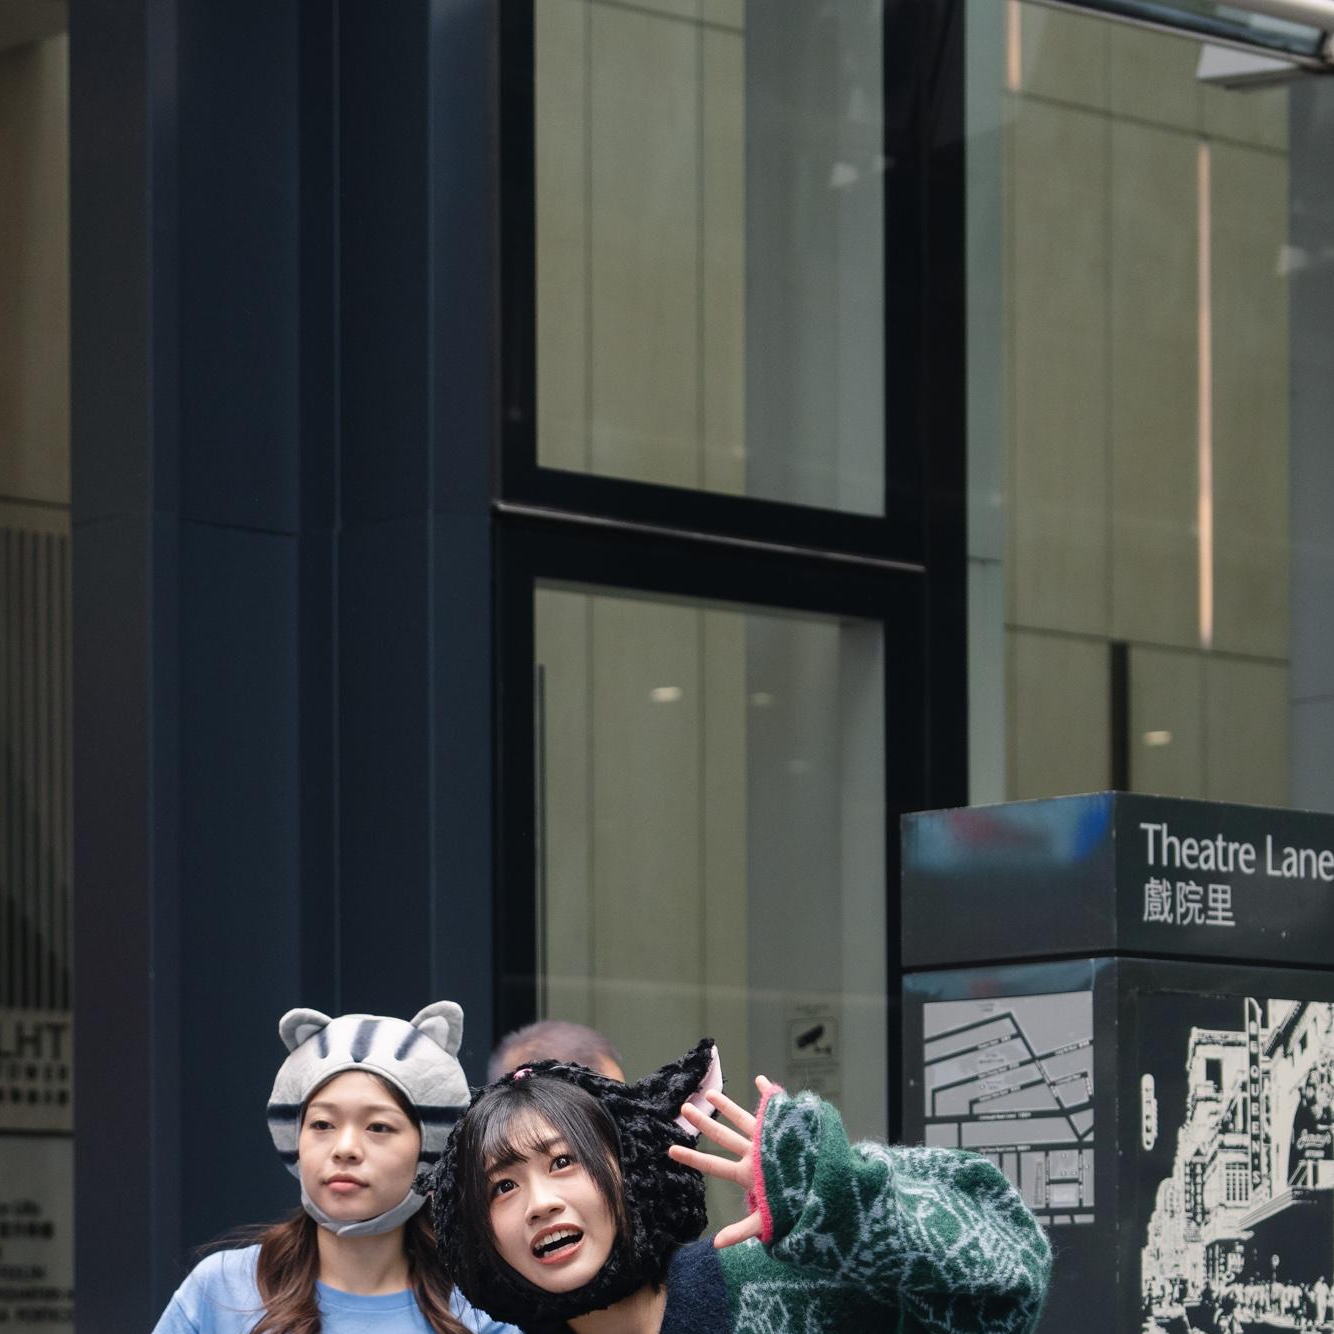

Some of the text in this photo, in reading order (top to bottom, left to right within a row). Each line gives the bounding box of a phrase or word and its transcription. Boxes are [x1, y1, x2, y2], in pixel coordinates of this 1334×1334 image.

[1139, 822, 1334, 881] Theatre Lane
[1143, 877, 1235, 926] 戲院里
